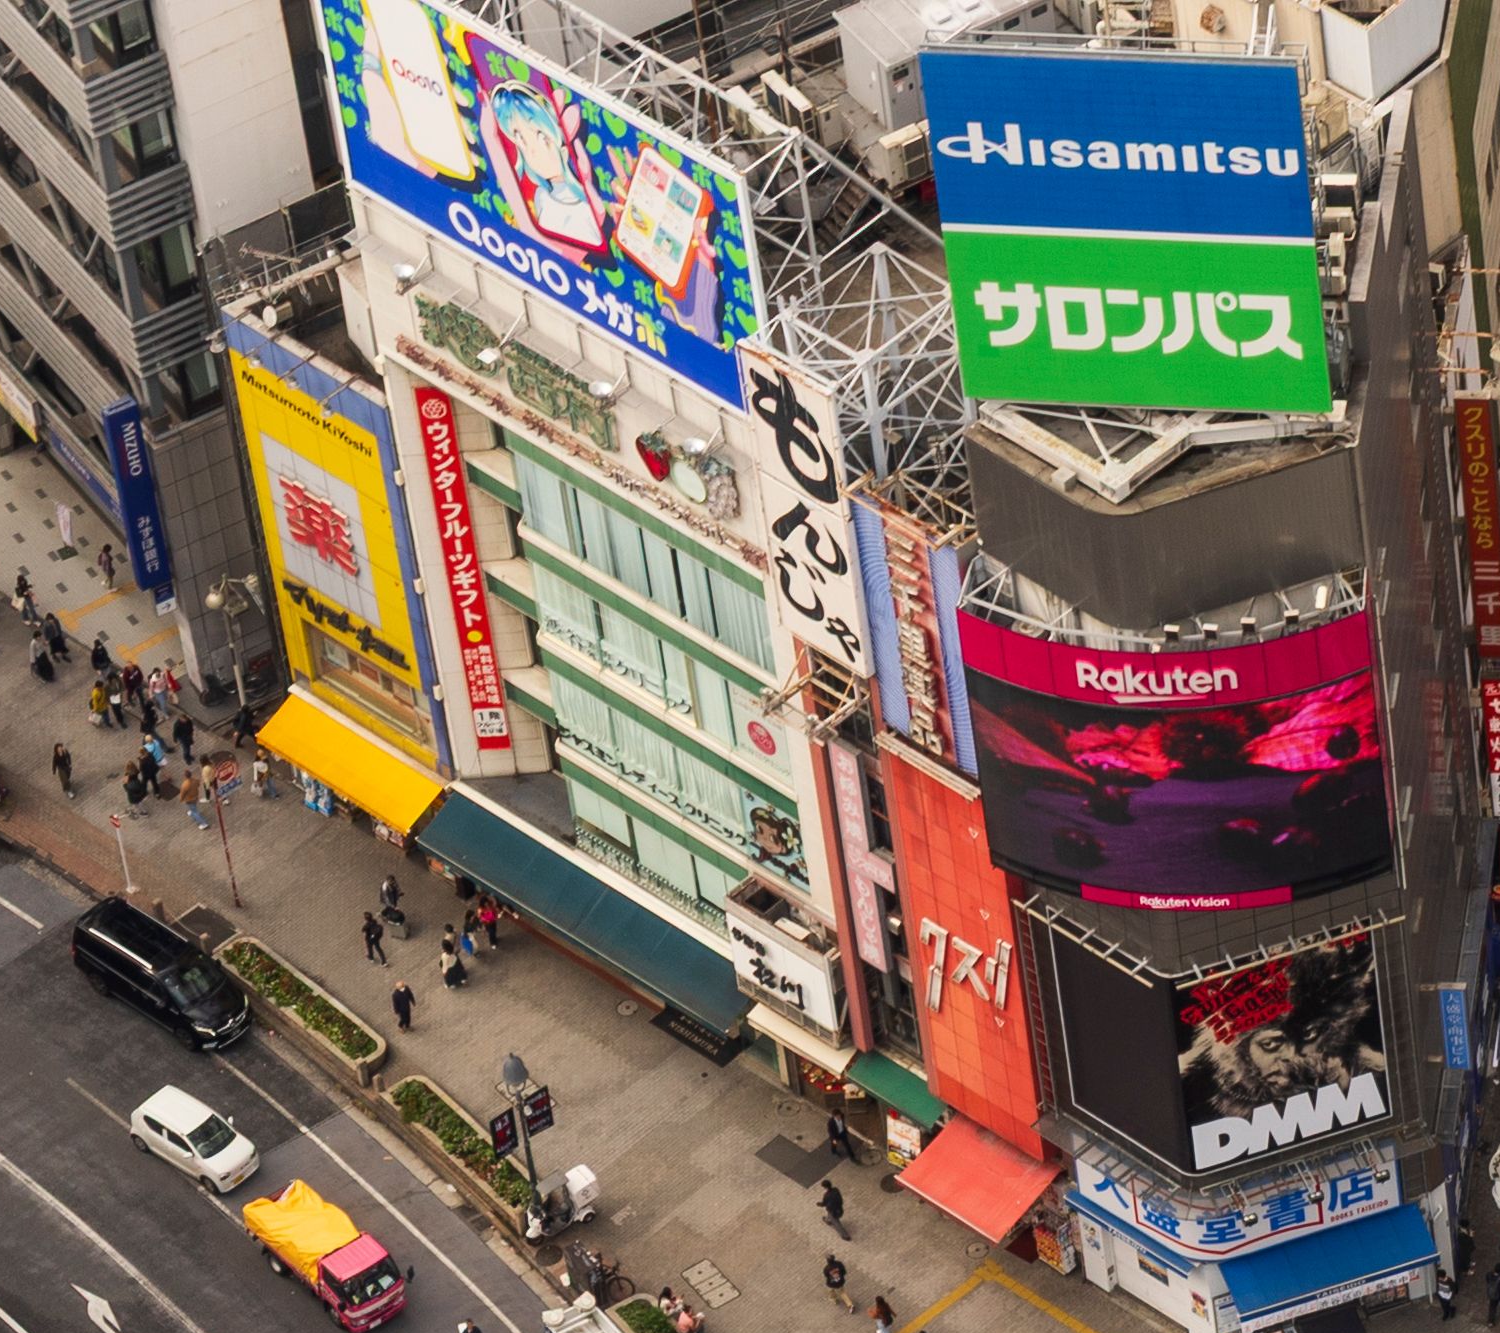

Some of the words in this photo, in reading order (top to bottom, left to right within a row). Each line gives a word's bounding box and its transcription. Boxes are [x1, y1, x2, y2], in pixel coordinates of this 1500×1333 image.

[391, 58, 444, 98] Qoo10
[937, 121, 1300, 177] Hisamitsu
[448, 201, 570, 300] Qoo10
[577, 277, 667, 357] メガポ
[974, 281, 1303, 360] サロンパス
[241, 370, 321, 430] Matsumoto
[121, 422, 143, 477] MIZUHO
[1463, 406, 1495, 550] クスリのことなら
[277, 474, 360, 578] 薬
[426, 421, 483, 629] ウィンターフルーツギフト
[750, 365, 863, 663] もんじゃ
[137, 516, 160, 574] みずほ銀行
[1075, 659, 1239, 698] Rakuten
[1139, 893, 1188, 910] Rakuten
[1189, 894, 1231, 909] Vision
[1191, 1072, 1387, 1171] DMM
[1356, 1199, 1389, 1216] TAISEIDO
